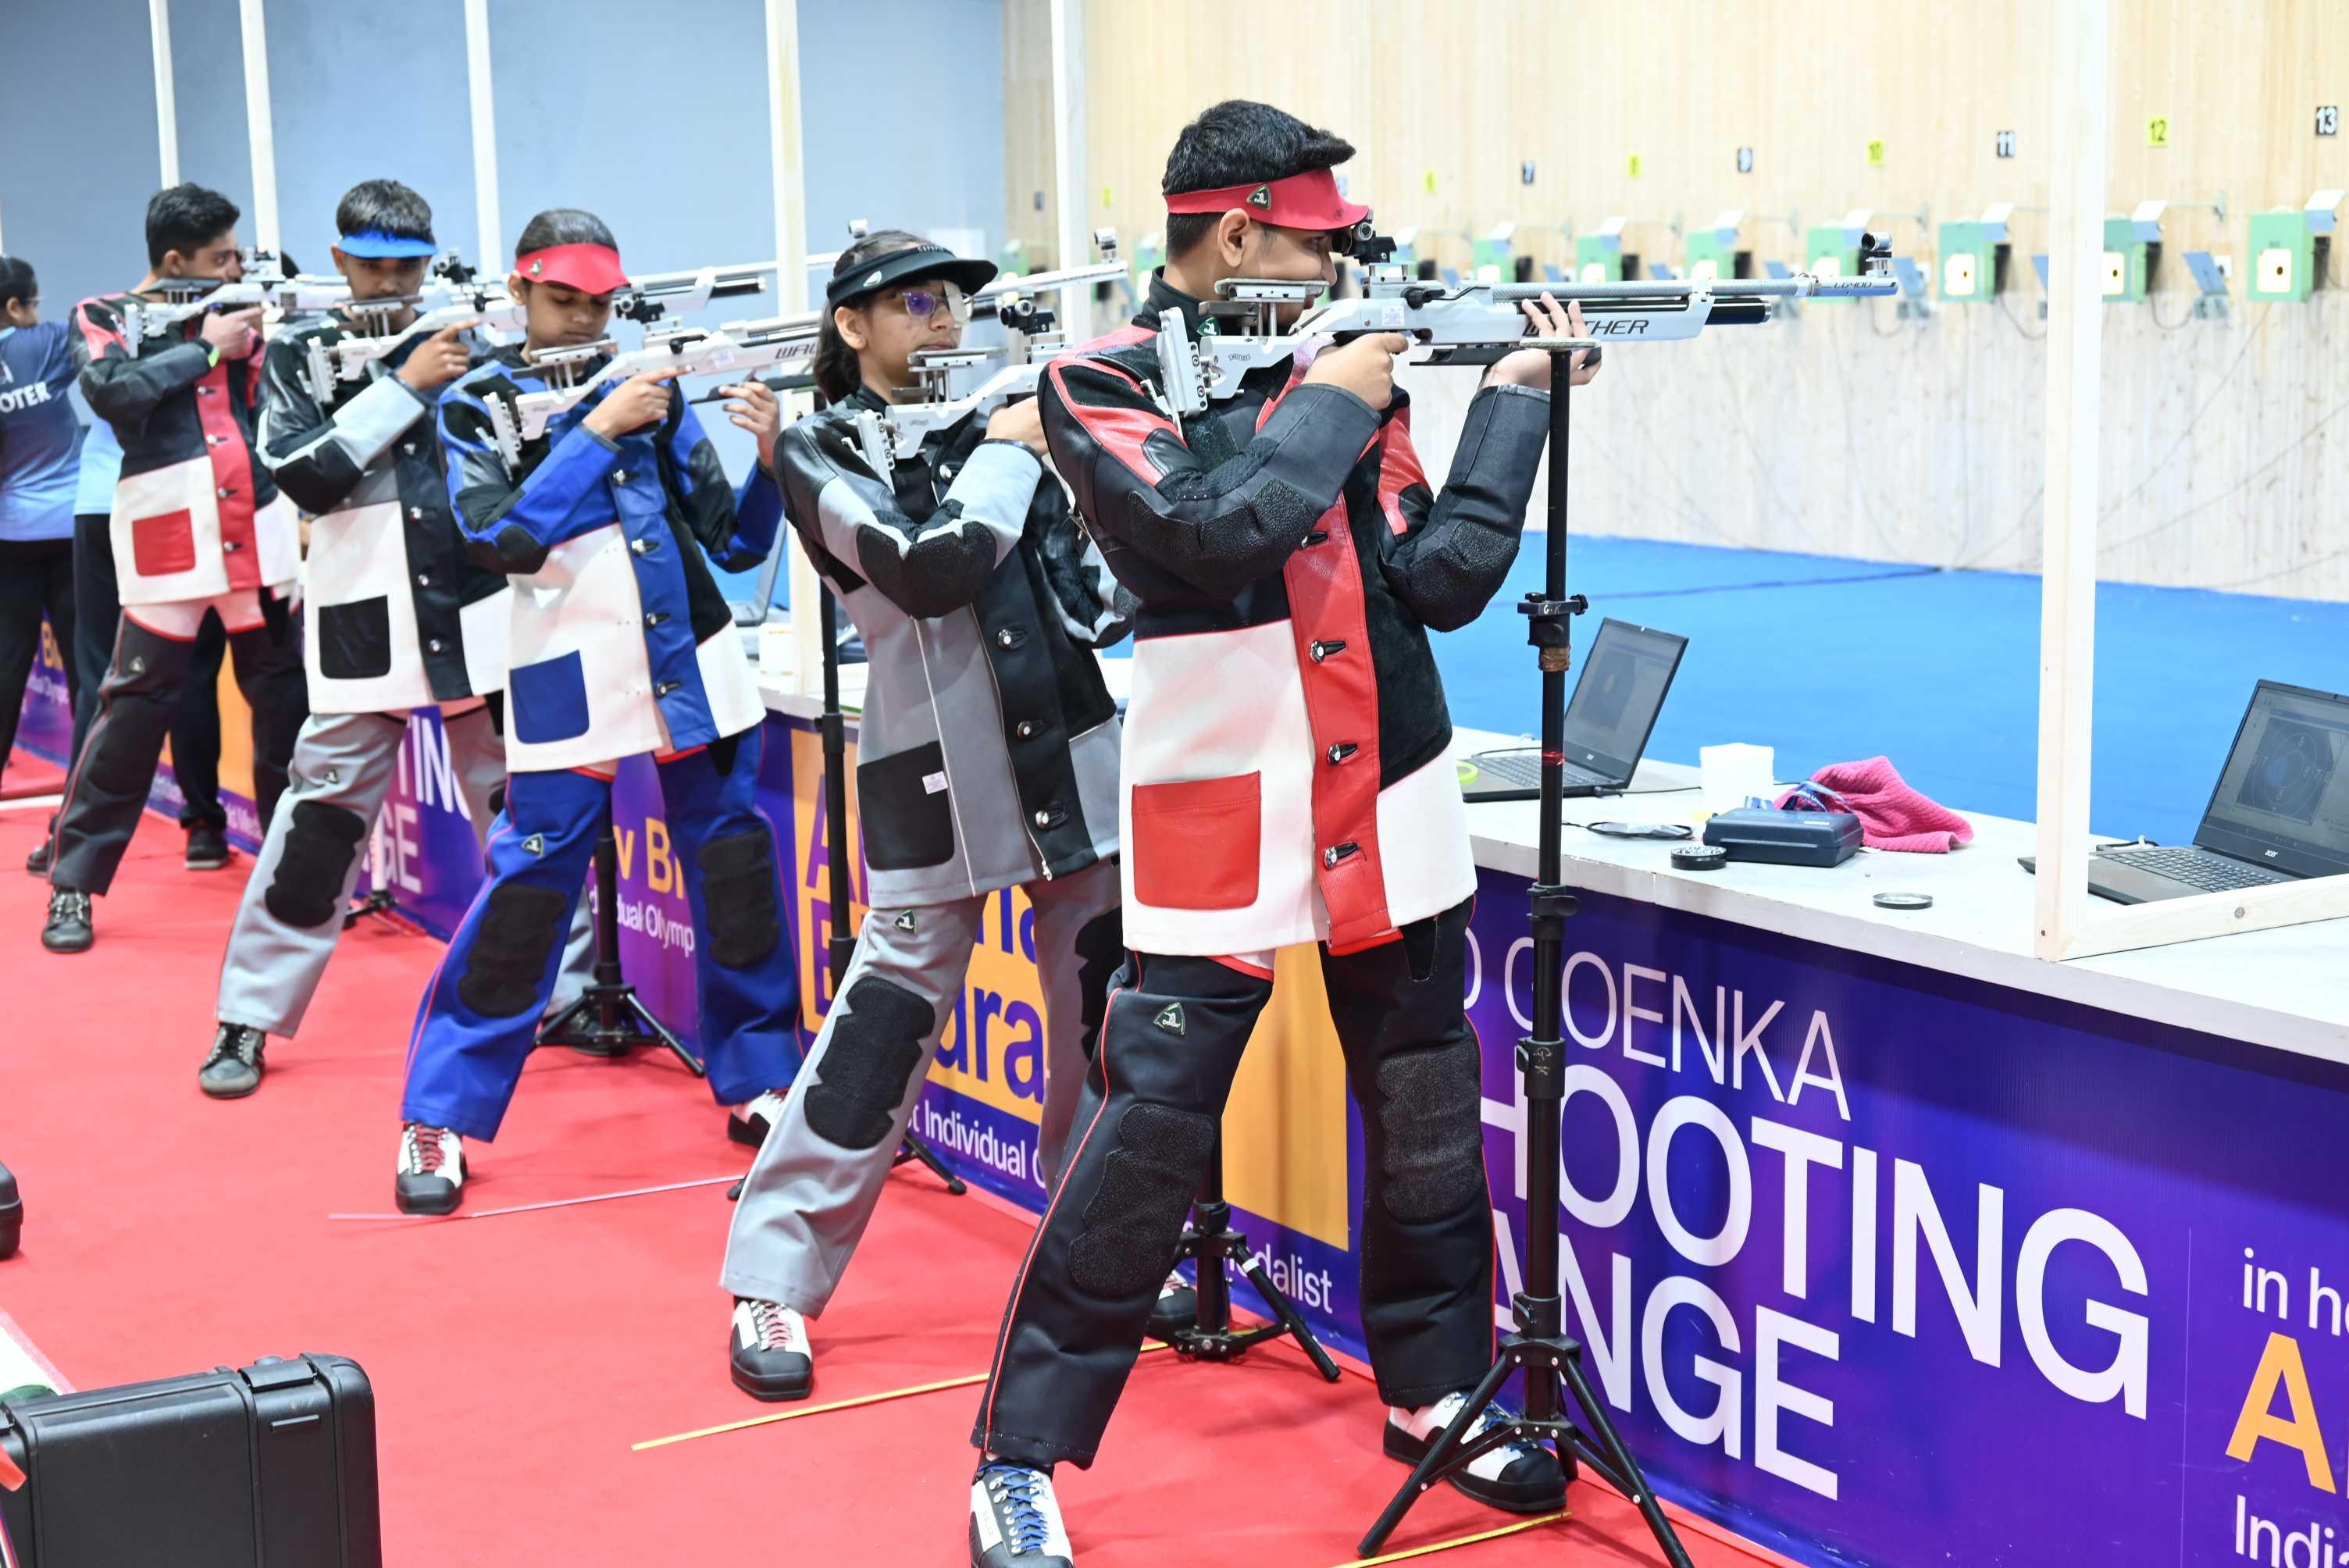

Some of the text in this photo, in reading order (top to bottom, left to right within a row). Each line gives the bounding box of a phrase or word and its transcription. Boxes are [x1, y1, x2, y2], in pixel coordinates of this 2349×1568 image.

[1998, 133, 2015, 155] 11
[2151, 120, 2167, 142] 12
[2317, 108, 2337, 134] 13
[925, 1099, 1027, 1180] Individual
[2243, 1247, 2349, 1337] in h
[2235, 1494, 2349, 1568] Indi
